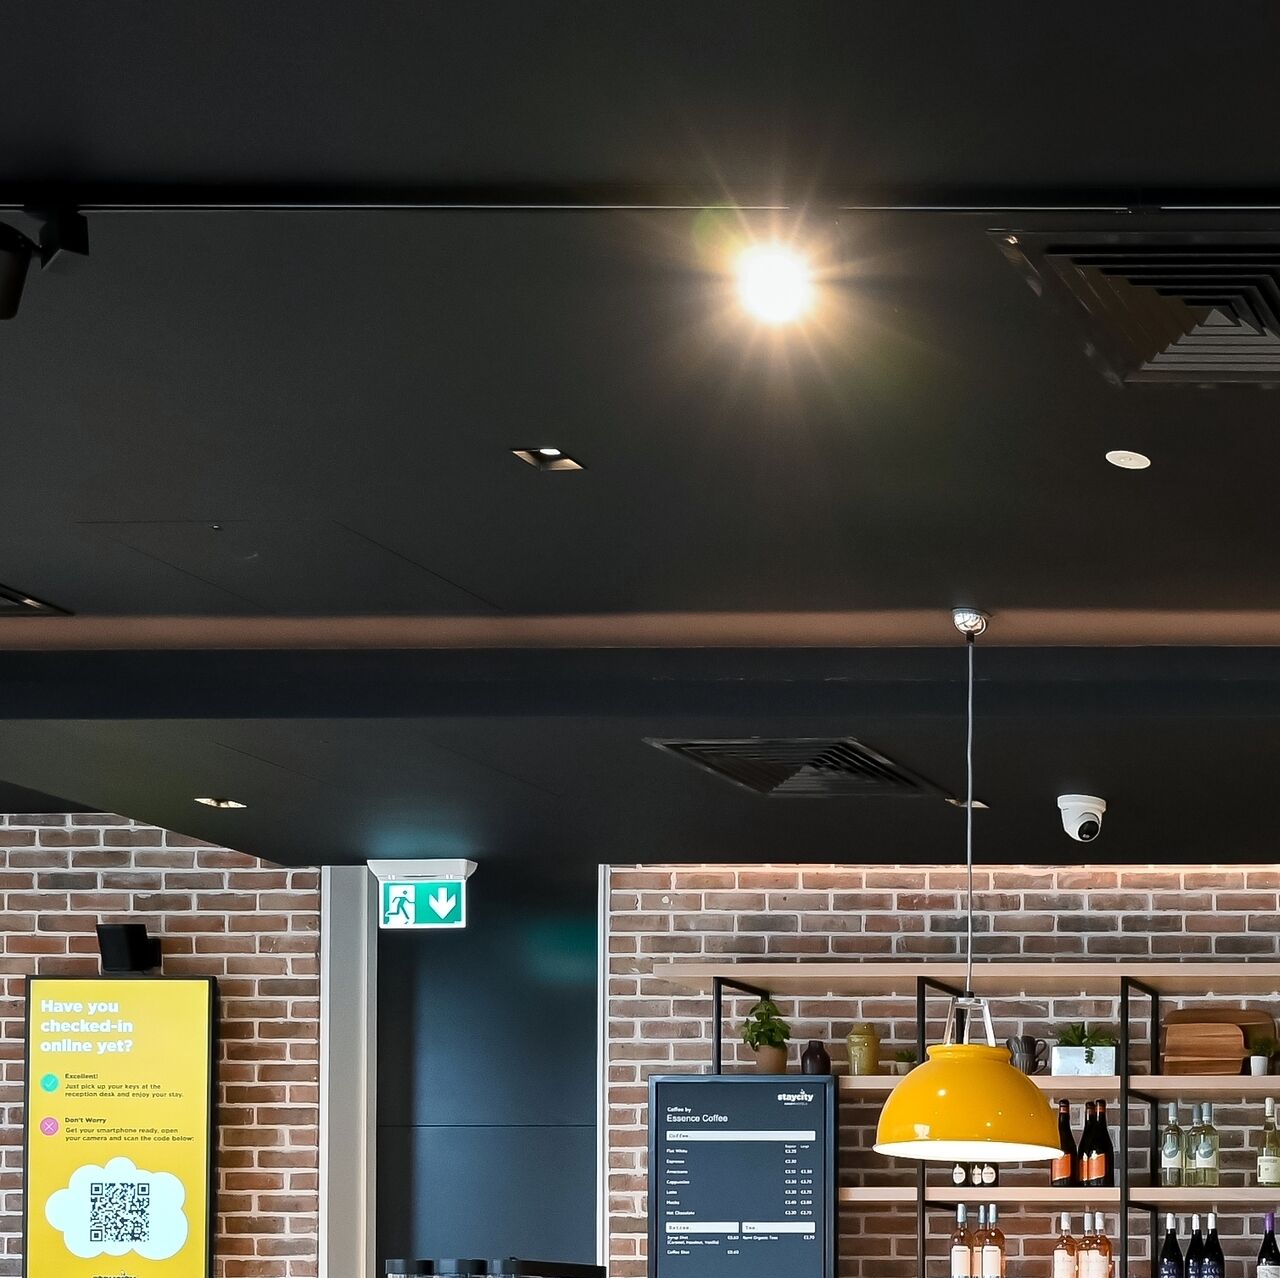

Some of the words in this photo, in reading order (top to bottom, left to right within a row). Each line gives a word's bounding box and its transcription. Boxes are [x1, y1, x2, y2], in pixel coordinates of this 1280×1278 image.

[41, 1000, 83, 1013] Have
[88, 1002, 119, 1016] you
[41, 1020, 133, 1033] checked-in
[41, 1039, 92, 1052] online
[97, 1039, 133, 1054] yet?
[777, 1090, 814, 1102] staycity
[667, 1114, 701, 1122] Essence
[702, 1114, 729, 1122] Coffee
